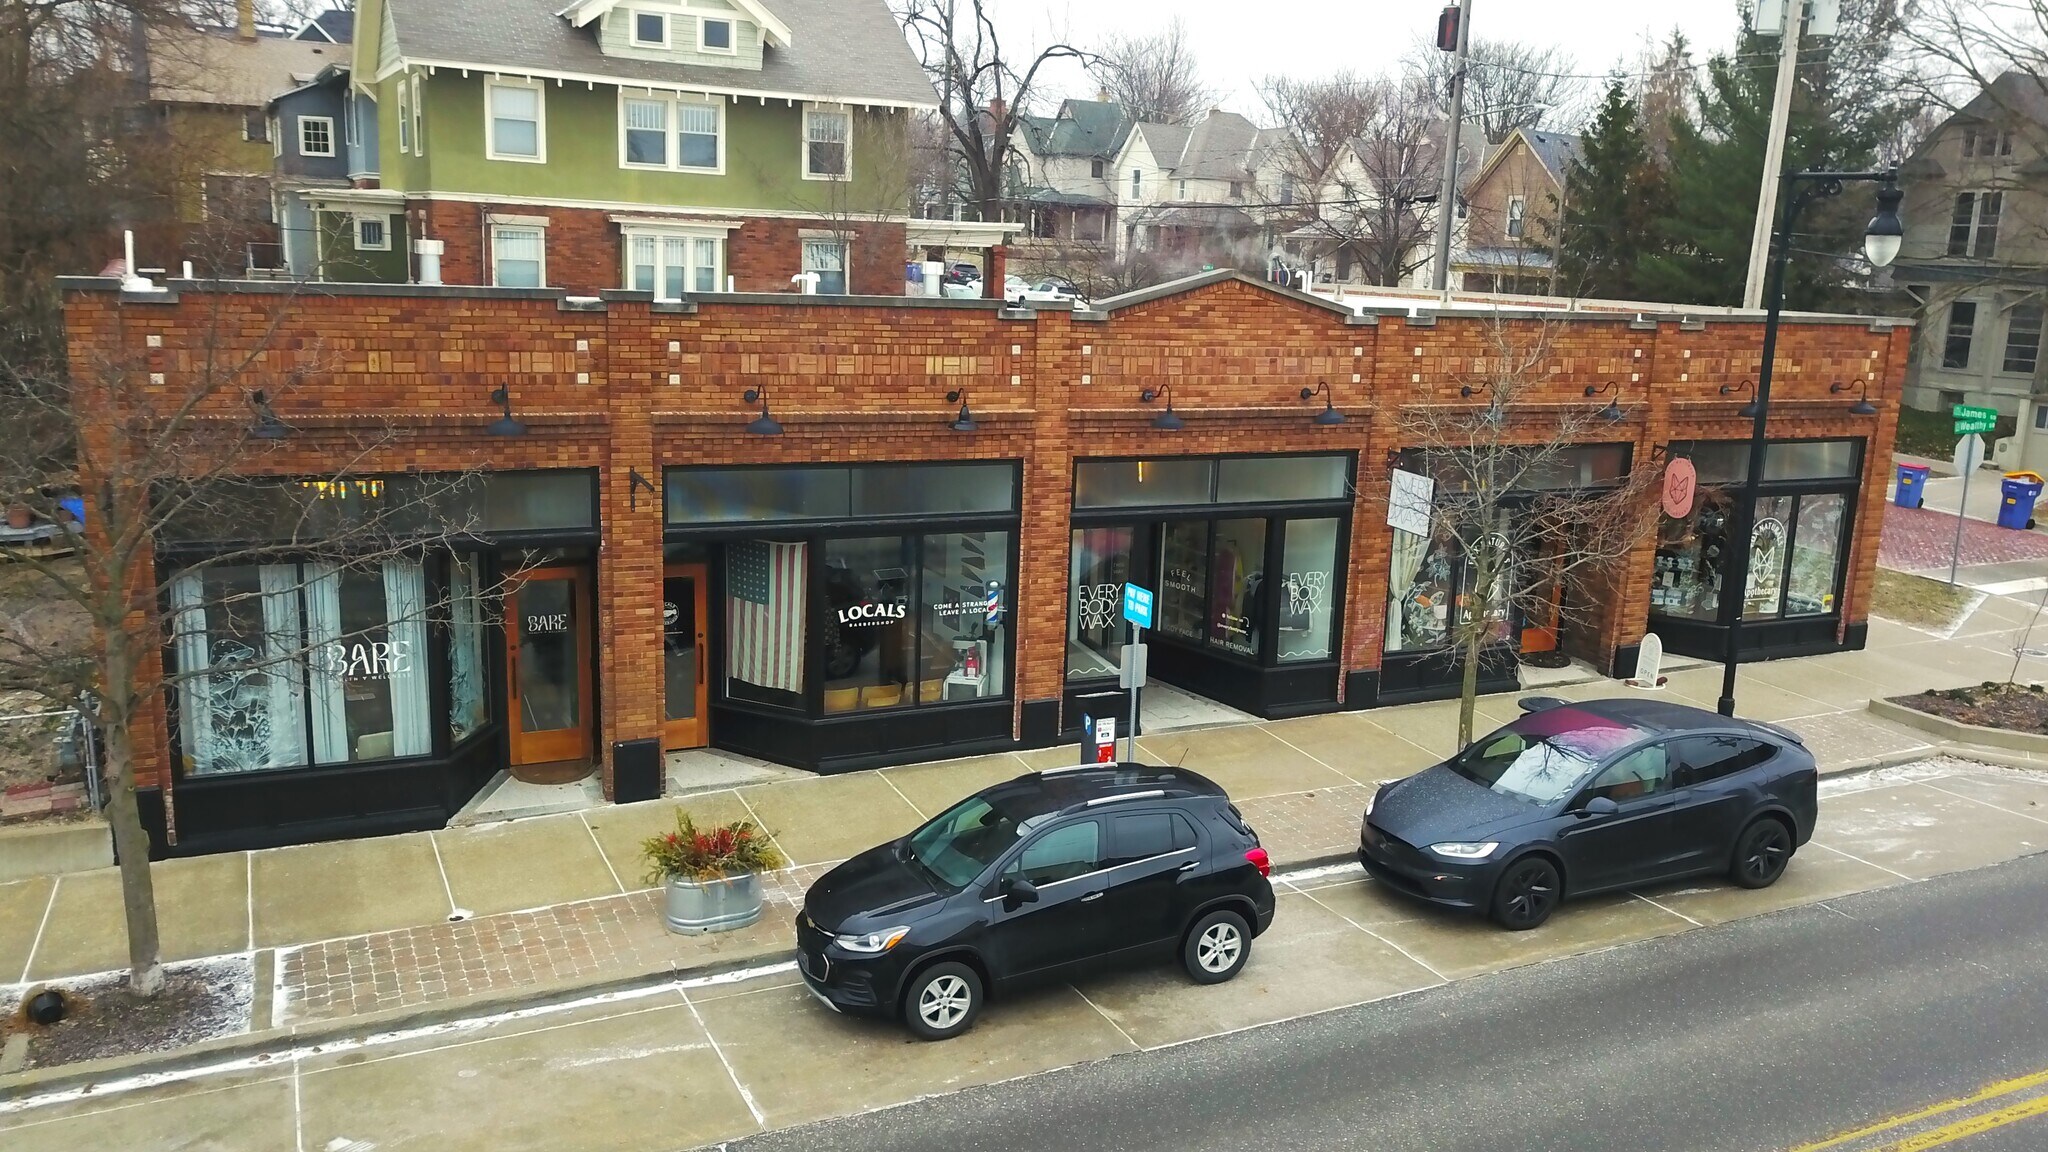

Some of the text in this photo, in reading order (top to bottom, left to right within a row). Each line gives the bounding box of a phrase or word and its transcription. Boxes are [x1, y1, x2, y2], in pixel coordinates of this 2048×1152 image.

[1961, 408, 1987, 419] James
[1960, 421, 1987, 431] Wealthy
[1759, 522, 1783, 546] NATURALS
[1171, 568, 1191, 581] FEEL
[1290, 571, 1329, 587] EVERY
[1079, 583, 1123, 601] EVERY
[1165, 580, 1196, 593] SMOOTH
[1290, 585, 1325, 601] BODY
[838, 603, 906, 624] LOCALS
[1080, 598, 1118, 616] BODY
[1290, 599, 1322, 615] WAX
[527, 613, 568, 632] BARE
[849, 620, 894, 628] BARBERSHOP
[1079, 613, 1115, 630] WAX
[1209, 636, 1255, 656] HAIR REMOVAL
[327, 640, 411, 676] BARE
